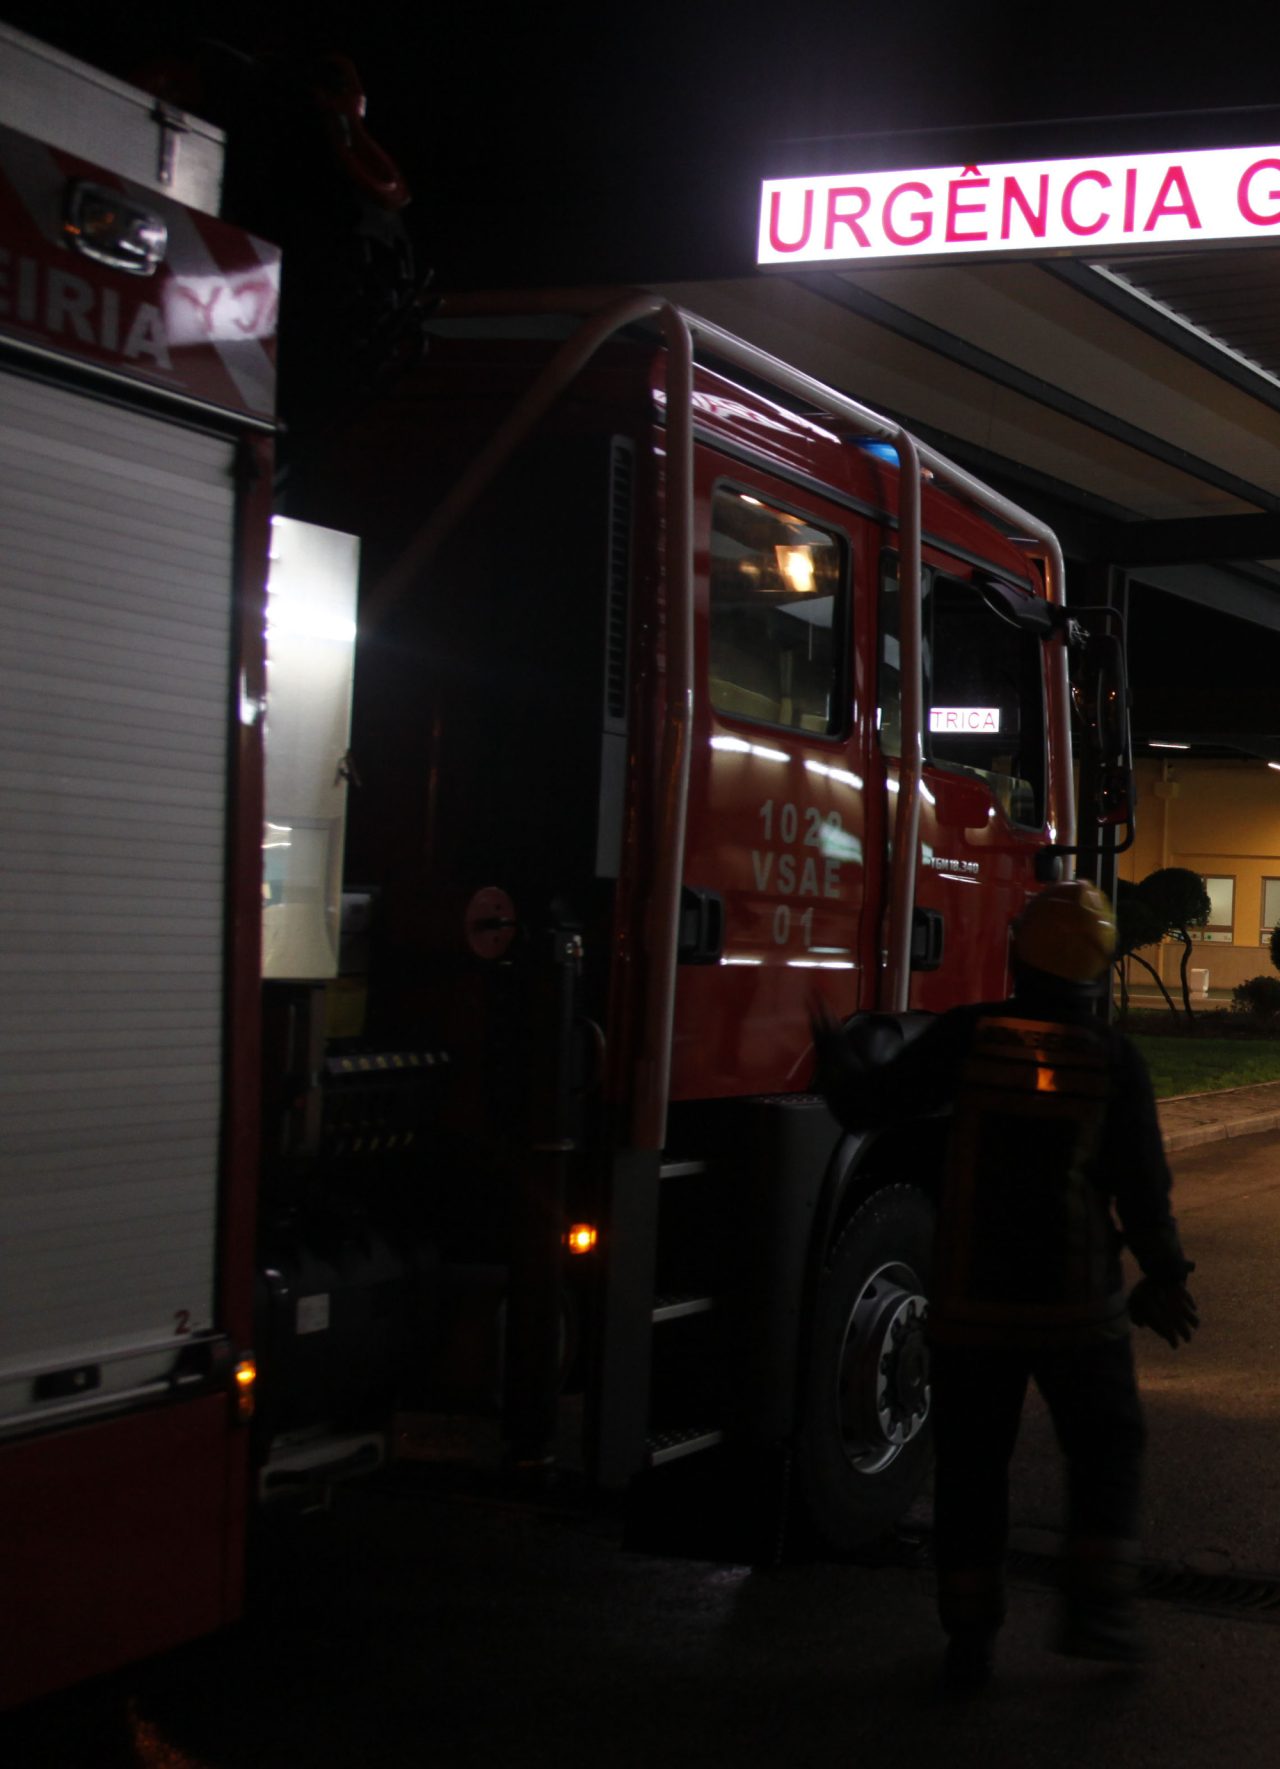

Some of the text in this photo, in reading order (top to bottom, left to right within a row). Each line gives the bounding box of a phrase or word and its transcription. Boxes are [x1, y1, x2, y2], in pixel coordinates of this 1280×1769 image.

[768, 163, 1202, 253] URGÊNCIA
[931, 711, 996, 730] TRICA
[751, 849, 842, 898] VSAE
